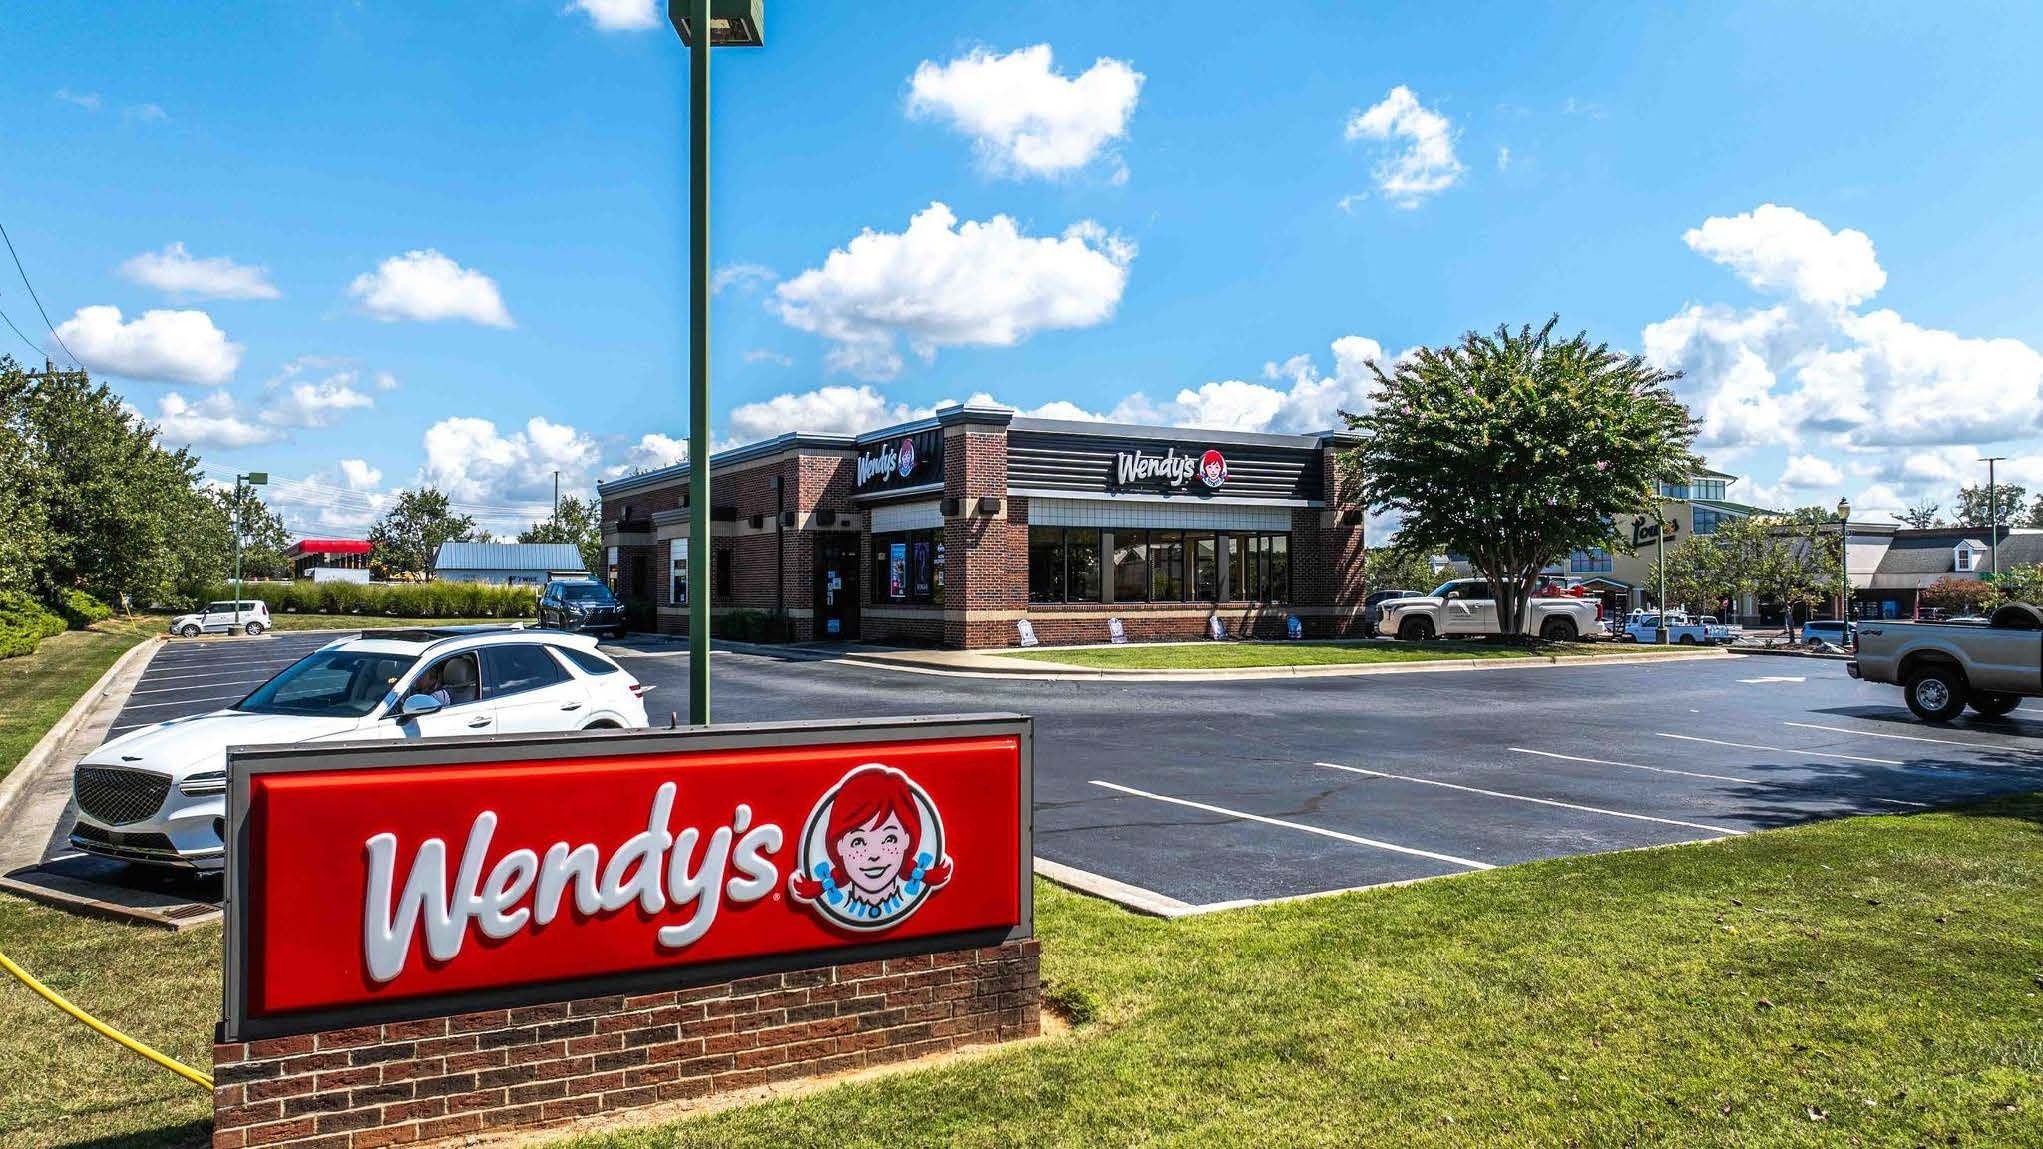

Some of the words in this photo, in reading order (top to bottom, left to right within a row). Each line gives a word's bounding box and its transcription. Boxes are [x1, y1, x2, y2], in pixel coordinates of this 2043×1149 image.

[857, 443, 897, 488] Wendy's
[1117, 447, 1195, 487] Wendy's
[364, 781, 784, 984] Wendy's
